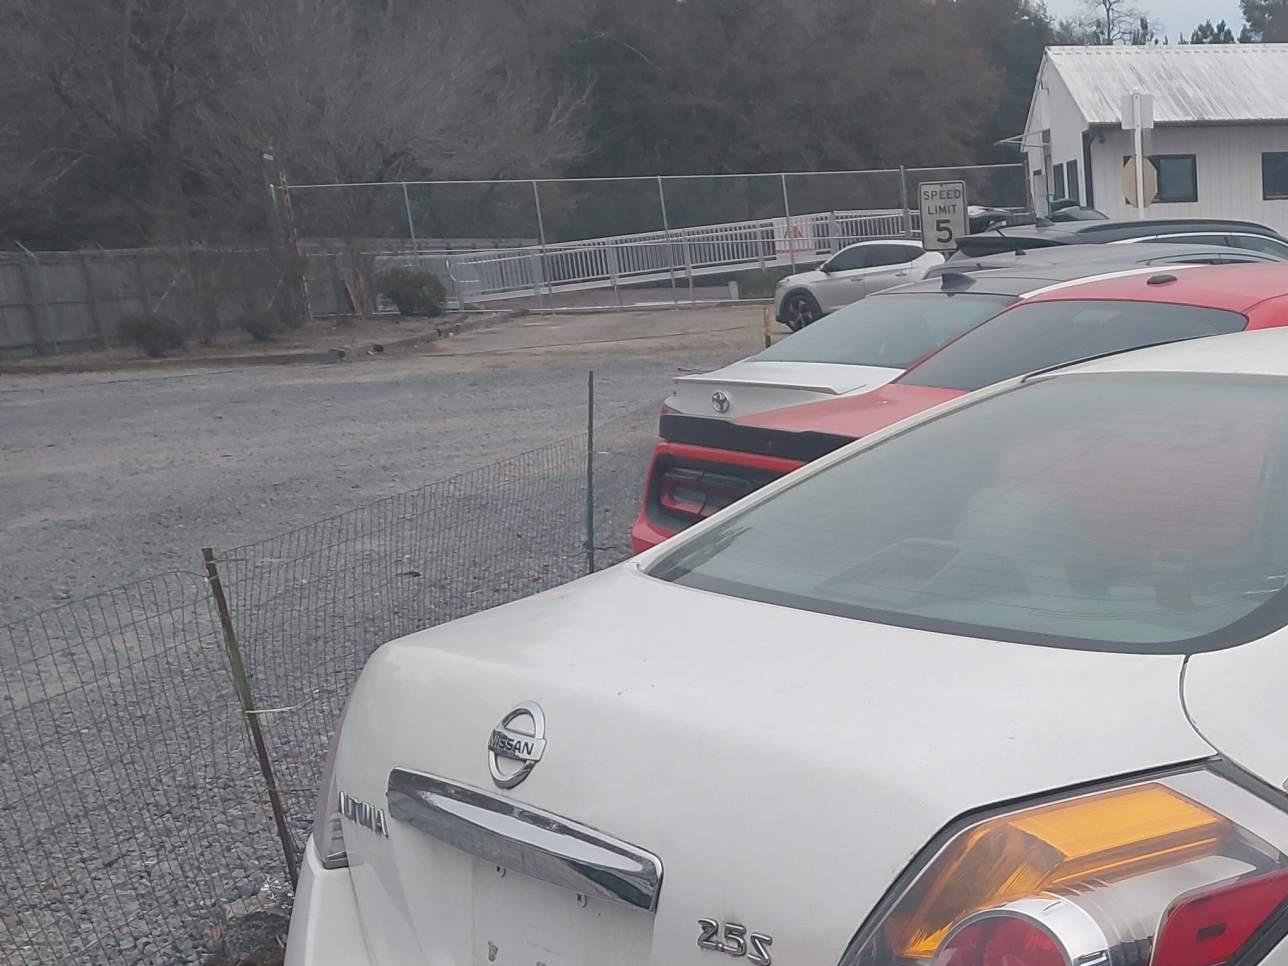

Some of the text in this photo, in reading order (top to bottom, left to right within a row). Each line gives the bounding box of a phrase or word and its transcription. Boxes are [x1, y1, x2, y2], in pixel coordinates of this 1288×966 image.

[923, 190, 961, 200] SPEED
[927, 204, 957, 215] LIMIT
[935, 219, 953, 243] 5
[489, 730, 535, 756] NISSAN
